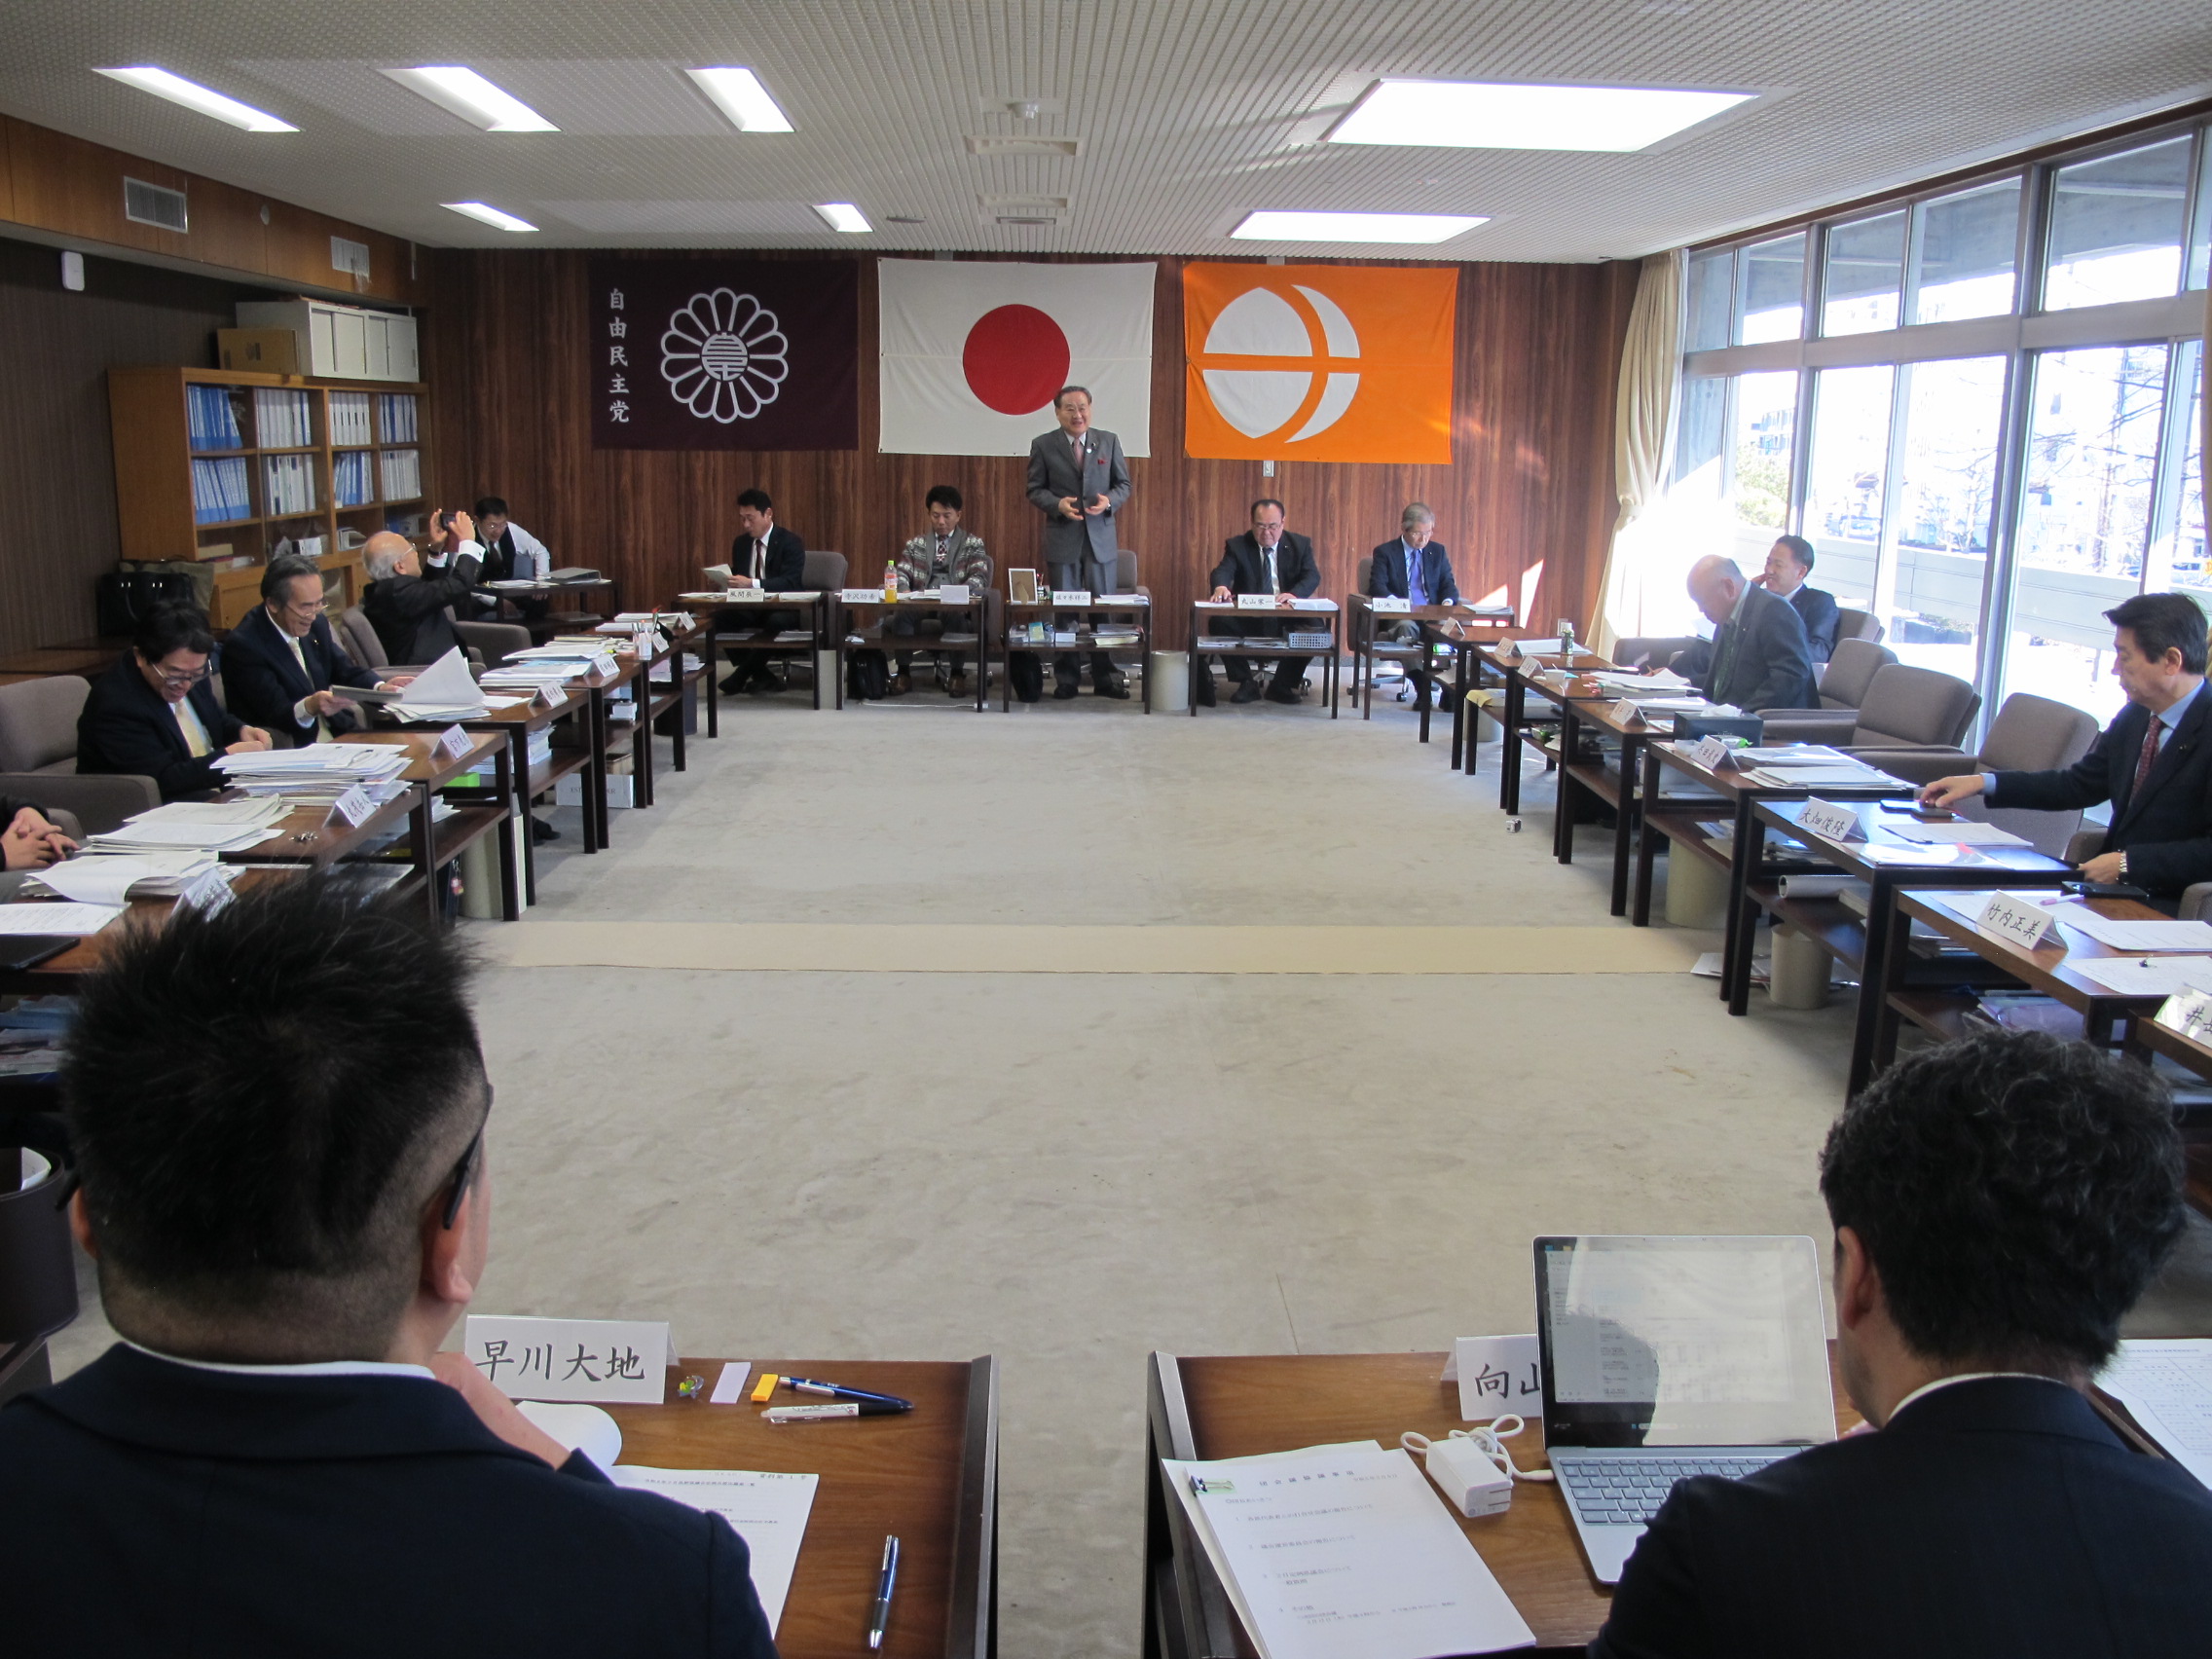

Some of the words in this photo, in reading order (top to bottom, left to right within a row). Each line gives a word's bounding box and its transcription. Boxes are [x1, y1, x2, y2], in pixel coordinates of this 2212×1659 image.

[608, 288, 630, 424] 自由民主党
[1798, 808, 1846, 836] 大畑俊隆
[1987, 903, 2043, 941] 竹内正美
[475, 1340, 645, 1382] 早川大地
[1474, 1363, 1541, 1399] 向山
